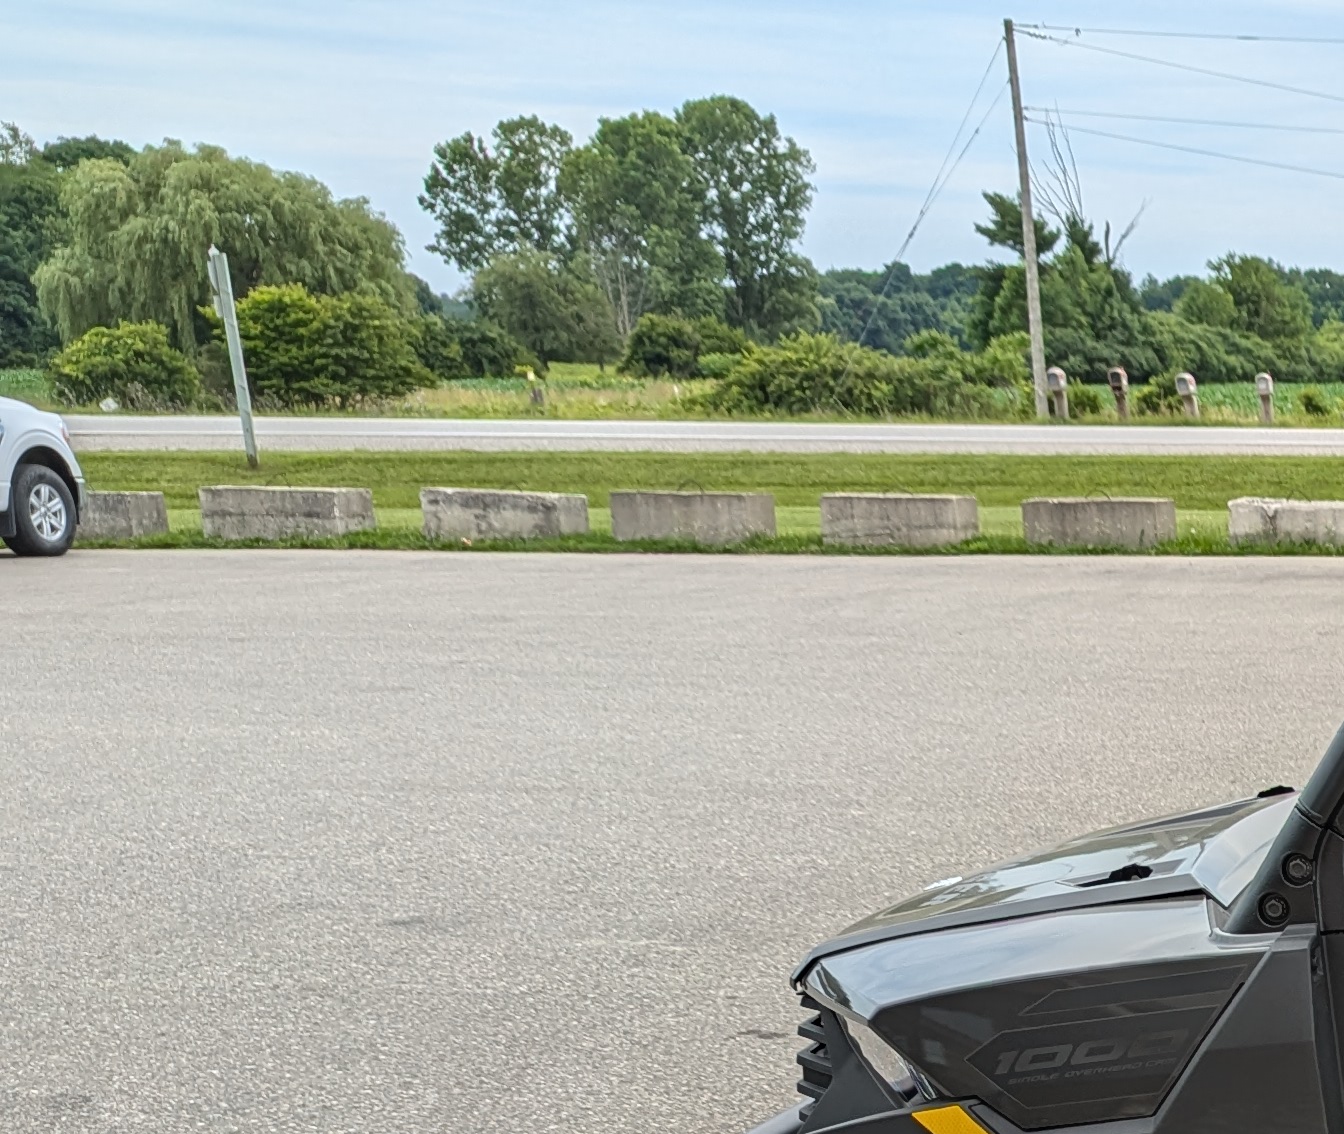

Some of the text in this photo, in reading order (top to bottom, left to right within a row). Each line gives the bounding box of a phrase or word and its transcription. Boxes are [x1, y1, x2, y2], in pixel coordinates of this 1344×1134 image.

[994, 1029, 1190, 1075] 1000
[1007, 1072, 1061, 1086] SINGLE
[1064, 1062, 1143, 1078] OVERHEAD
